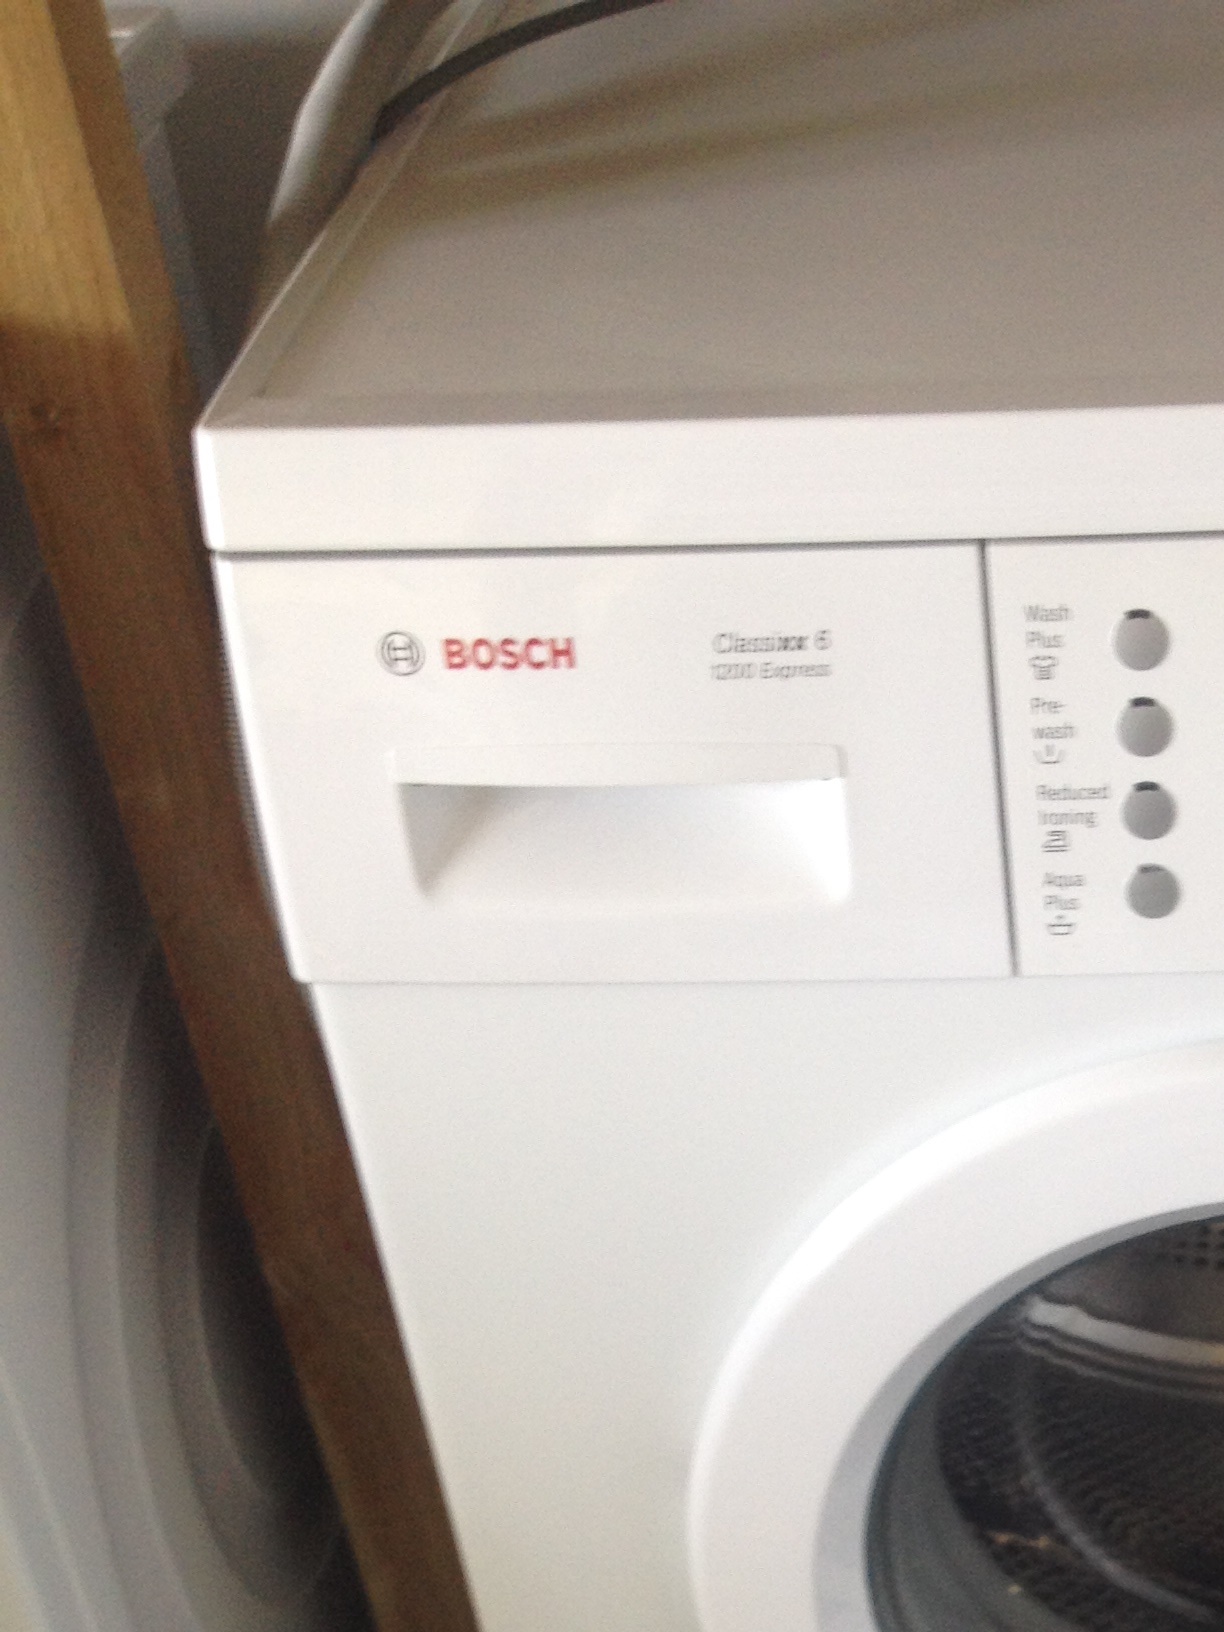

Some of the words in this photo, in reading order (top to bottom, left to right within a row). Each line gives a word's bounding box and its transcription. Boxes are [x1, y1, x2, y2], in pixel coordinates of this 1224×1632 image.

[1024, 605, 1073, 622] Wash
[813, 629, 833, 650] 6
[1025, 631, 1065, 649] Plus
[442, 637, 577, 671] BOSCH
[760, 662, 833, 680] Express
[1033, 725, 1076, 740] wash
[1035, 785, 1111, 800] Reduced
[1038, 811, 1098, 828] Ironing
[1043, 873, 1086, 888] Aqua
[1043, 895, 1081, 910] Plus
